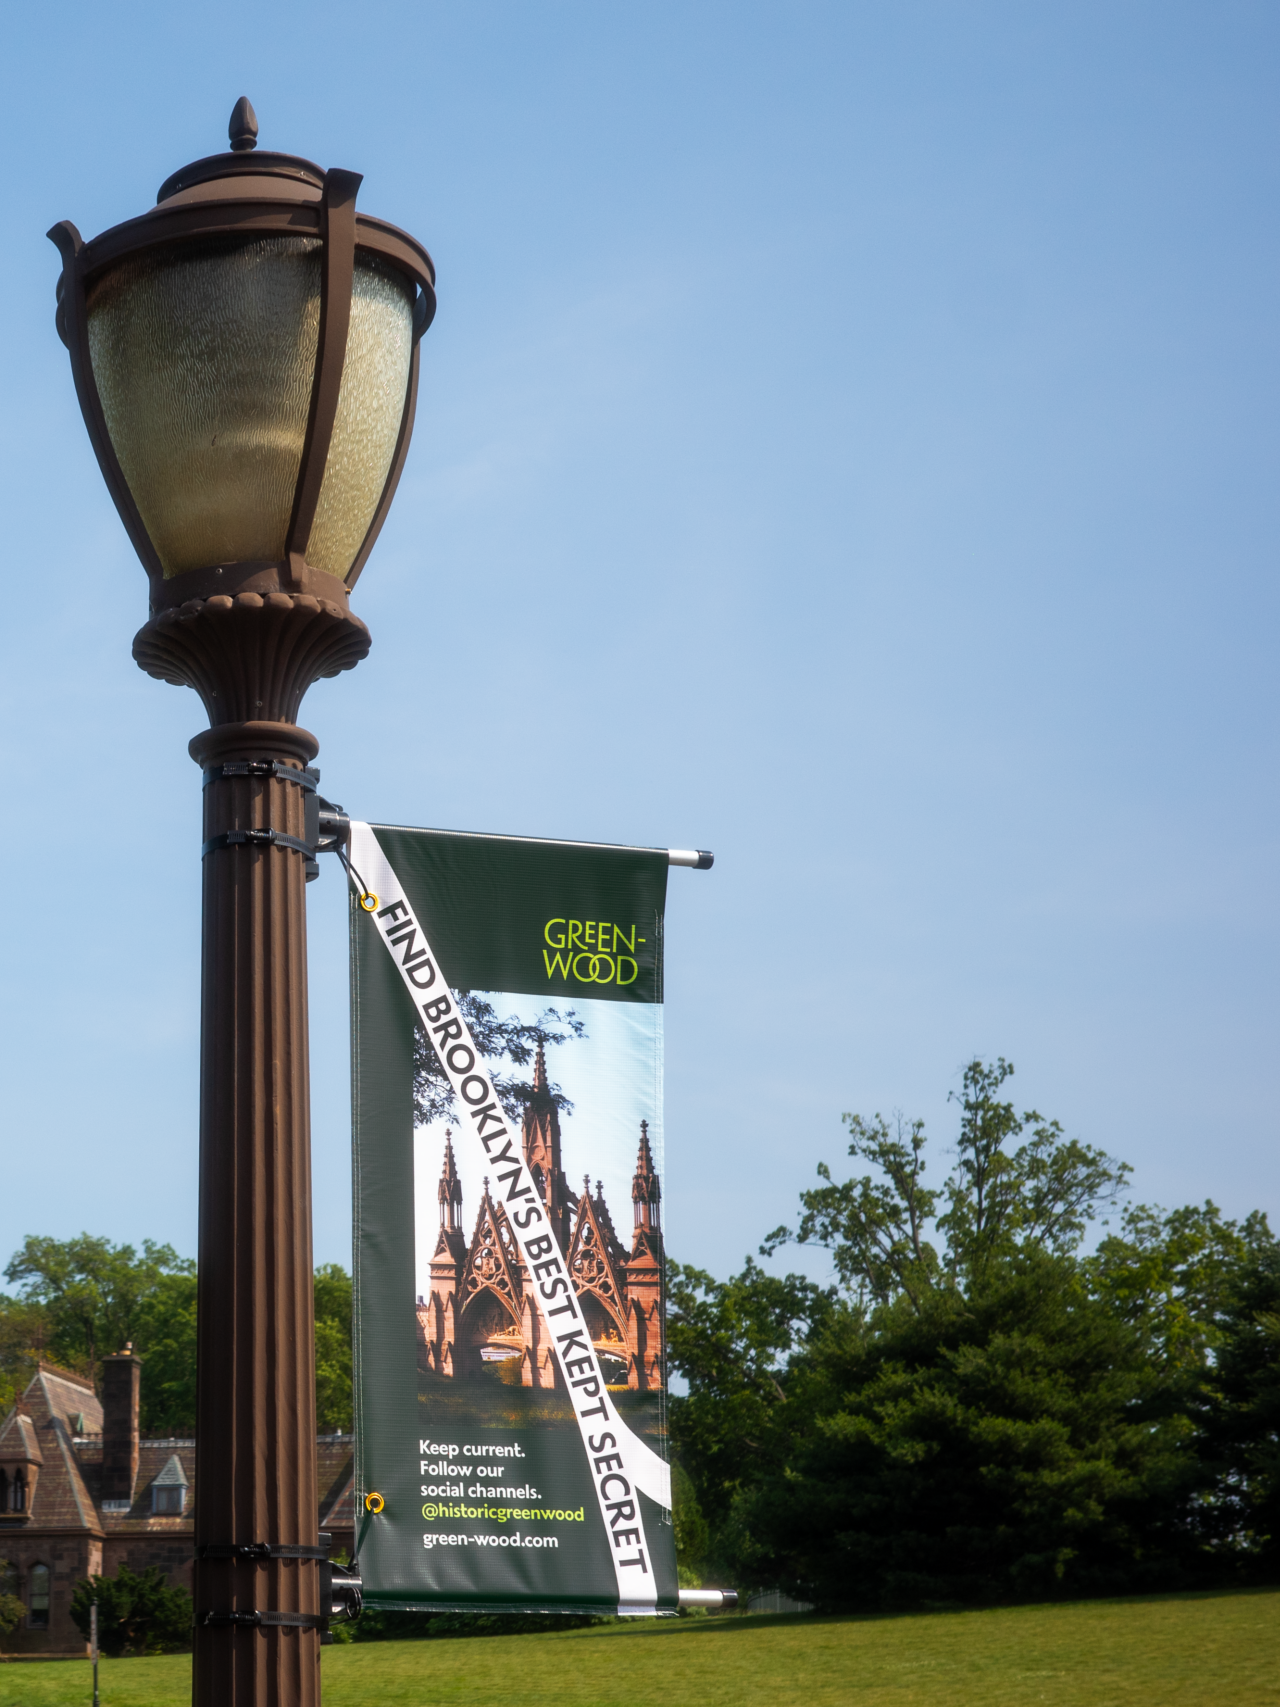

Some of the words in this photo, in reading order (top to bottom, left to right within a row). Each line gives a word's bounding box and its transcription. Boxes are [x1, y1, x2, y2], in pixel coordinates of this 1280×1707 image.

[544, 918, 646, 954] GREEN-
[543, 949, 638, 985] WOOD
[377, 899, 437, 990] FIND
[422, 994, 542, 1229] BROOKLYN'S
[524, 1232, 579, 1320] BEST
[556, 1329, 610, 1422] KEPT
[589, 1431, 648, 1574] SECRET
[419, 1439, 459, 1459] Keep
[463, 1441, 526, 1458] current.
[420, 1461, 473, 1477] Follow
[476, 1465, 504, 1477] our
[421, 1482, 464, 1498] social
[468, 1483, 542, 1500] channels.
[422, 1503, 585, 1523] @historicgreenwood
[423, 1531, 559, 1549] green-wood.com
